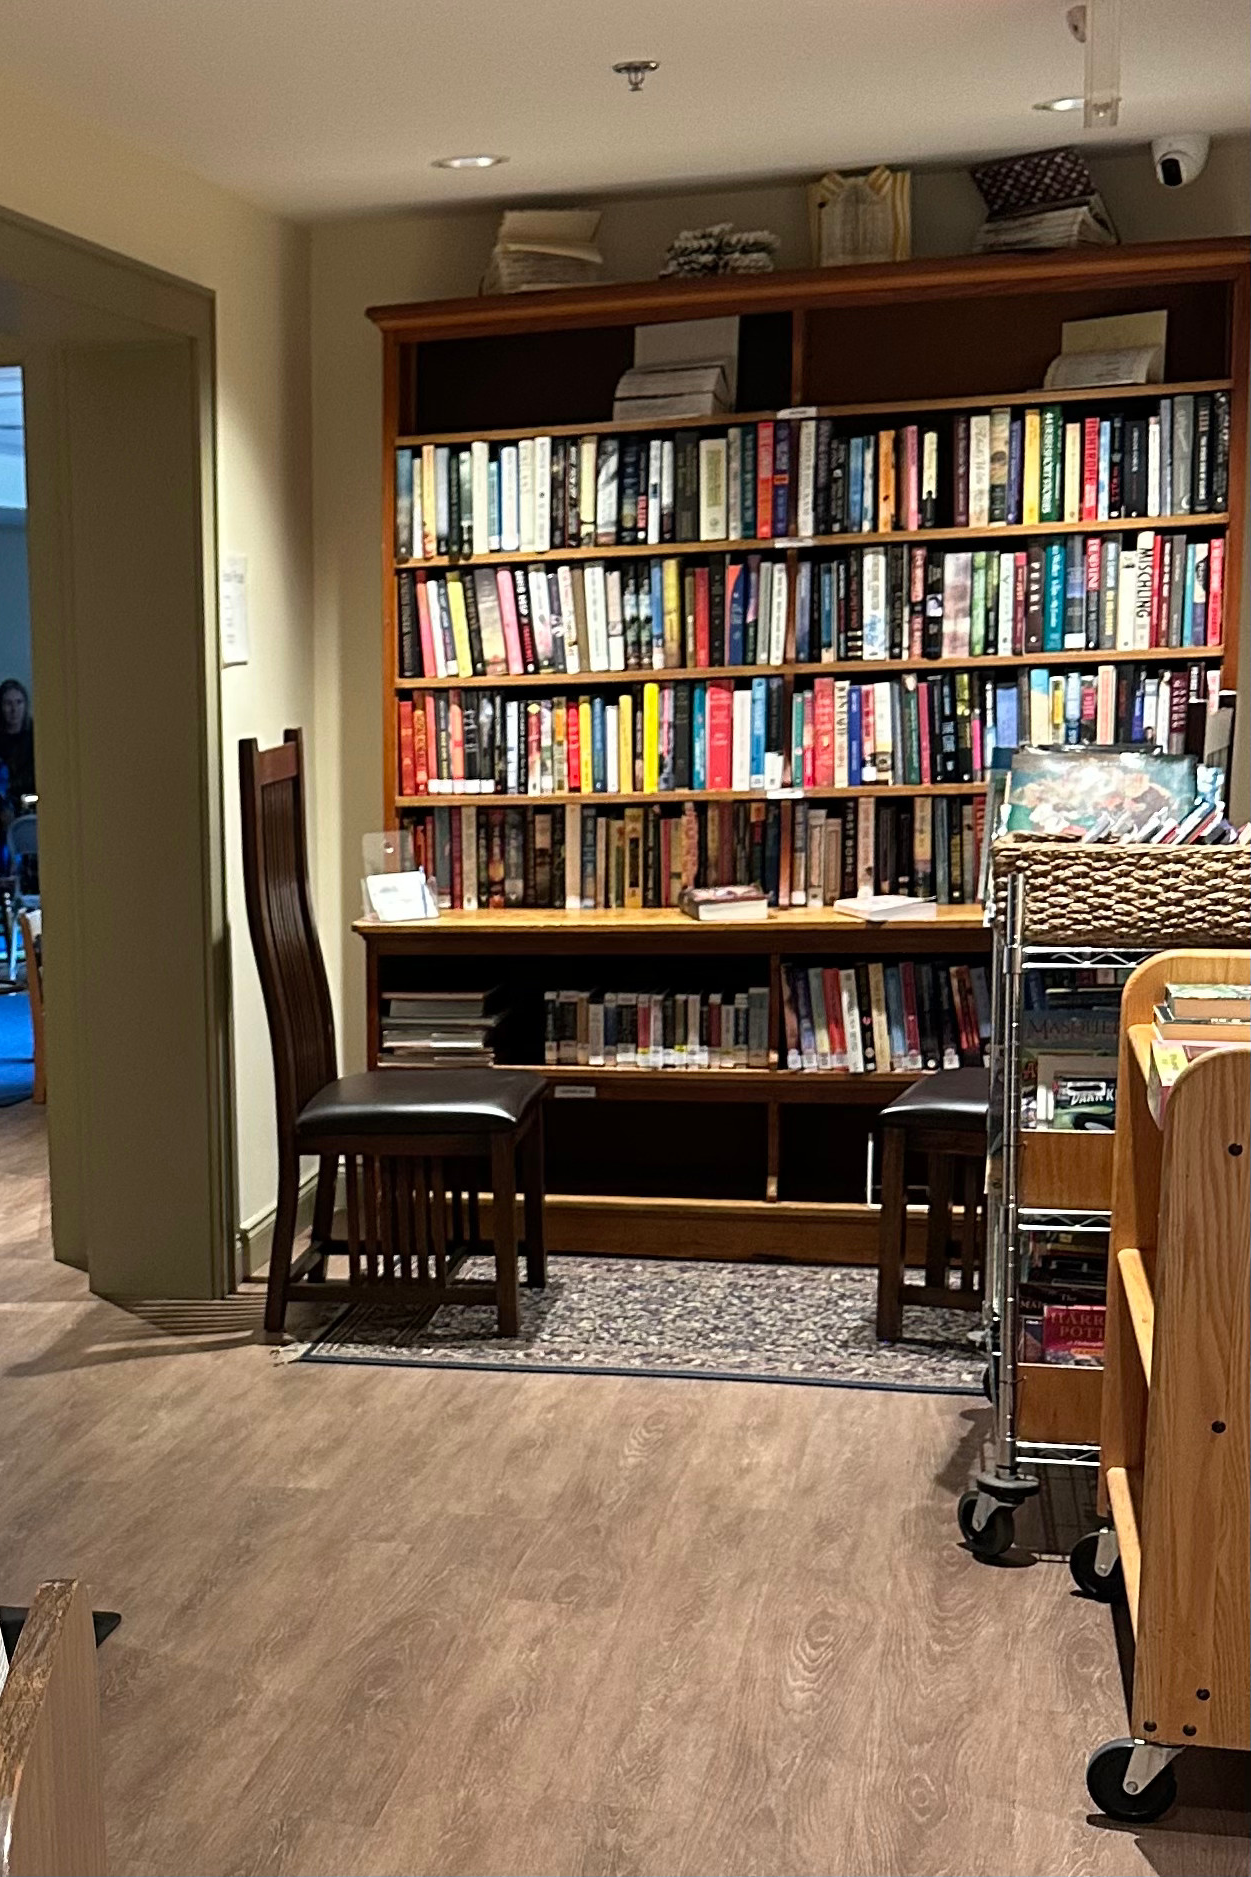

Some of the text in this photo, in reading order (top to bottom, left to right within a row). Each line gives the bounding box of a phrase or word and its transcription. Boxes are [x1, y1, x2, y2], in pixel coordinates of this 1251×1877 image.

[1085, 418, 1100, 487] TIGHTROPE
[1137, 547, 1153, 618] MISCHLING
[1050, 1312, 1104, 1326] HARR
